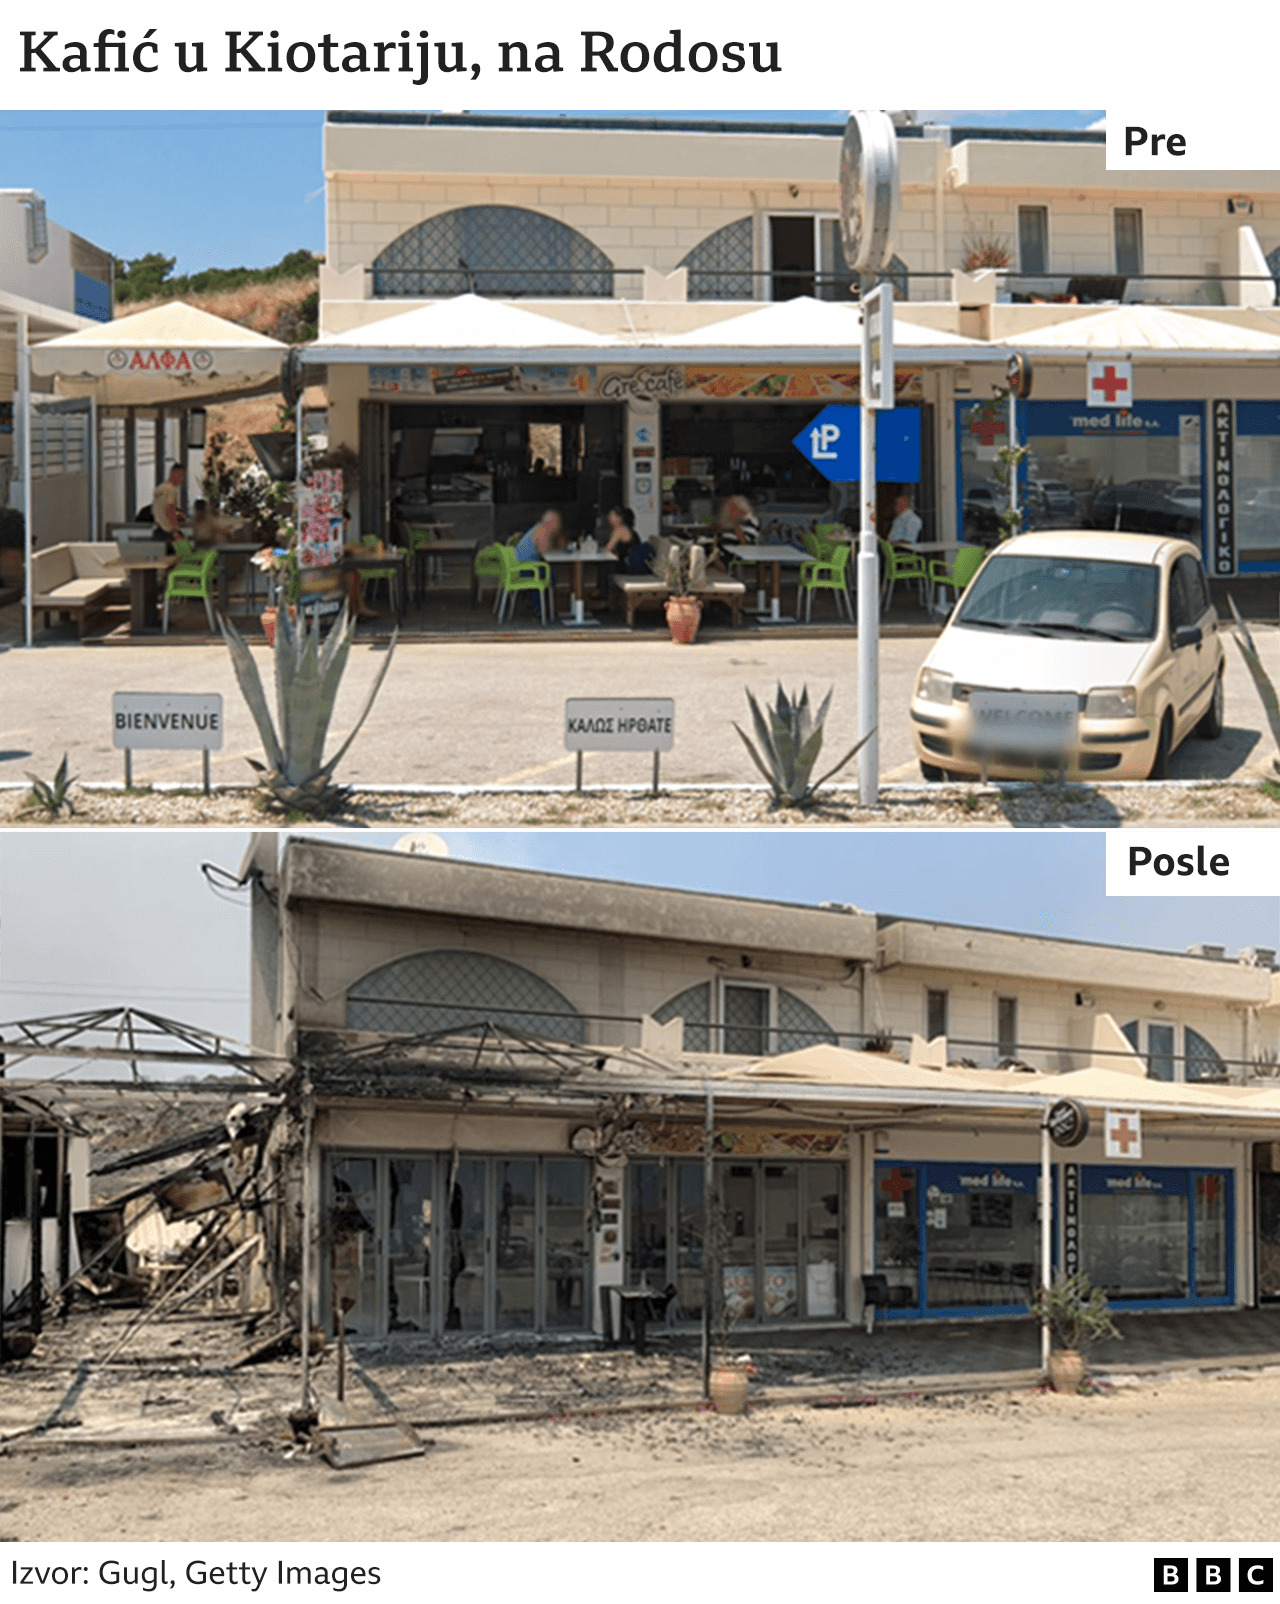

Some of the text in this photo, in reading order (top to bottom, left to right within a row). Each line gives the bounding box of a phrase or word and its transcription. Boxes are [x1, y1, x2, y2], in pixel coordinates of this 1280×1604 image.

[1073, 414, 1110, 427] med
[1115, 412, 1143, 427] life
[115, 713, 219, 730] BIENVENUE
[567, 718, 672, 733] ΚΑΛΩΣ ΗΡΘΑΤΕ
